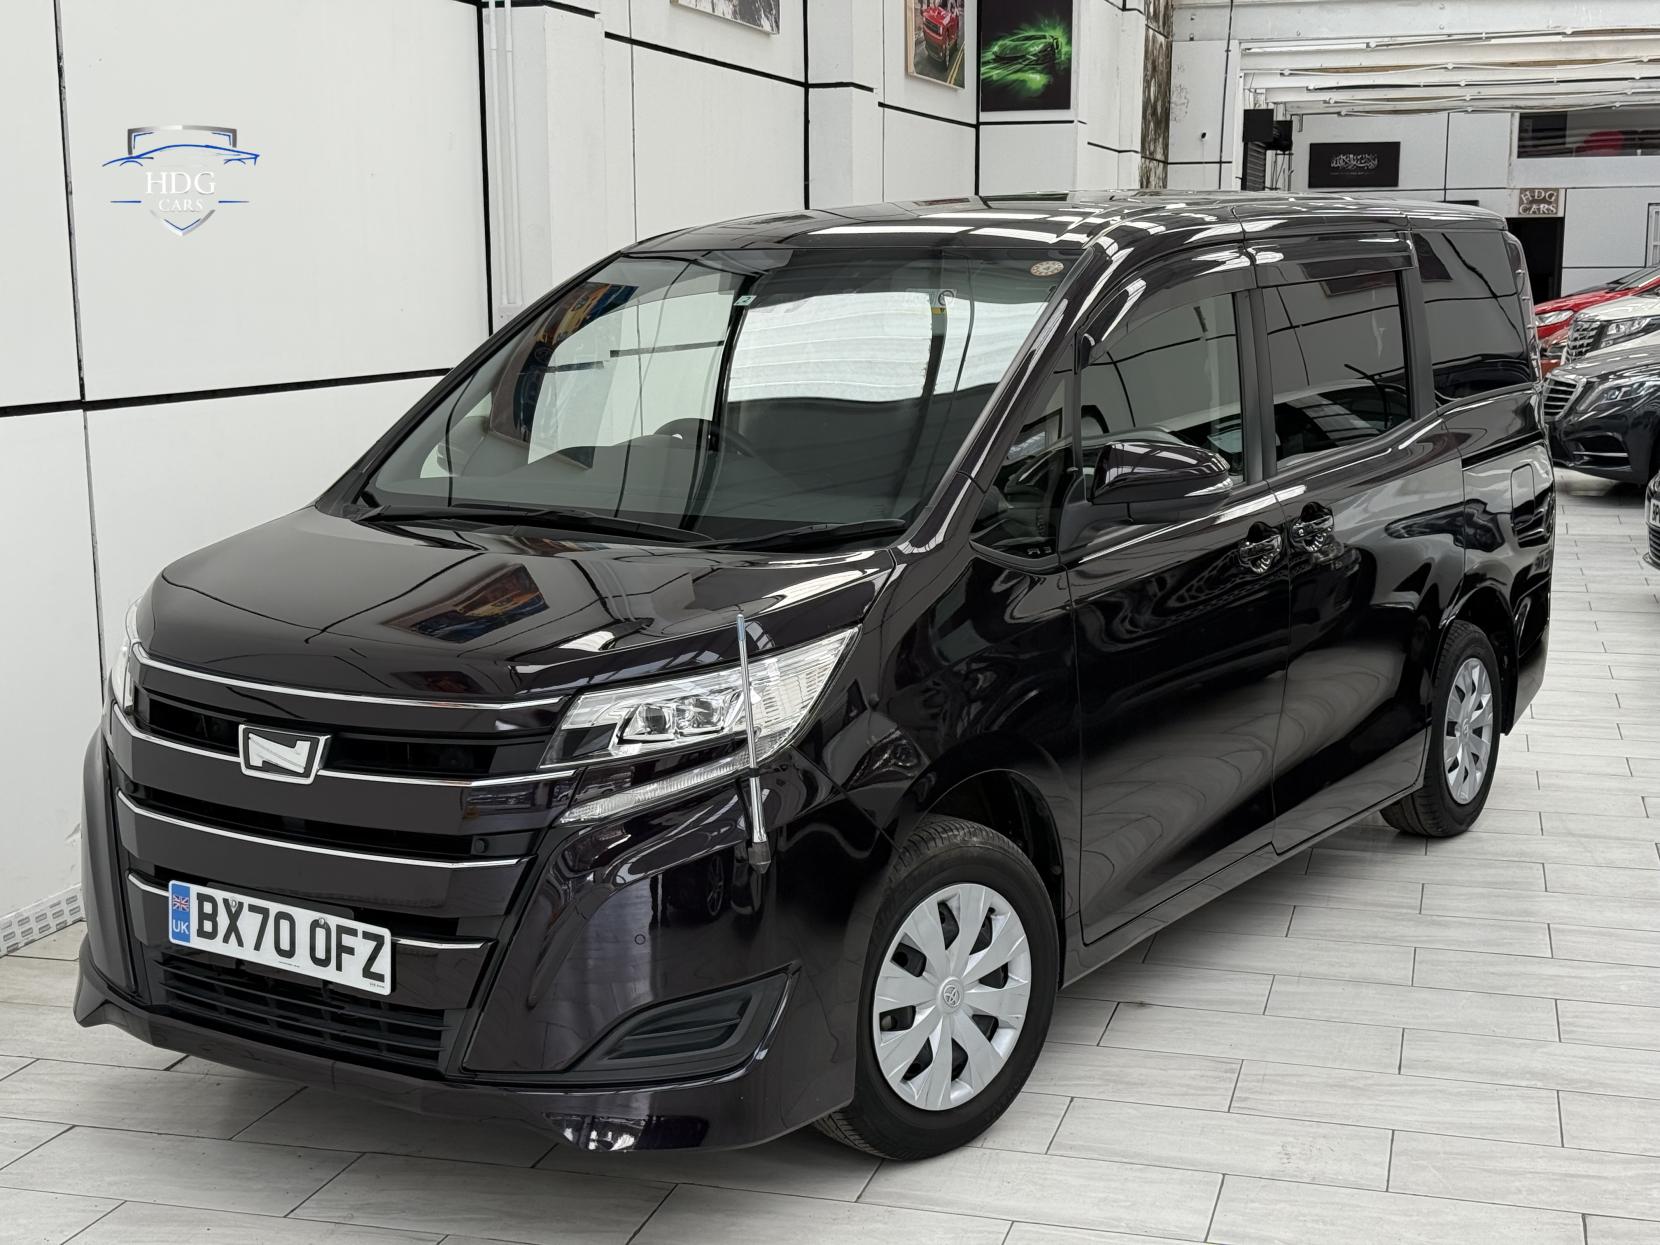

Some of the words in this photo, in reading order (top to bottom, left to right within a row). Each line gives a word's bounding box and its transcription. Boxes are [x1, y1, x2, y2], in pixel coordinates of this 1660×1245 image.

[1521, 189, 1557, 203] HDG
[1519, 203, 1556, 215] CARS
[172, 919, 189, 935] UK
[196, 892, 296, 960] BX70
[309, 918, 386, 983] OFZ
